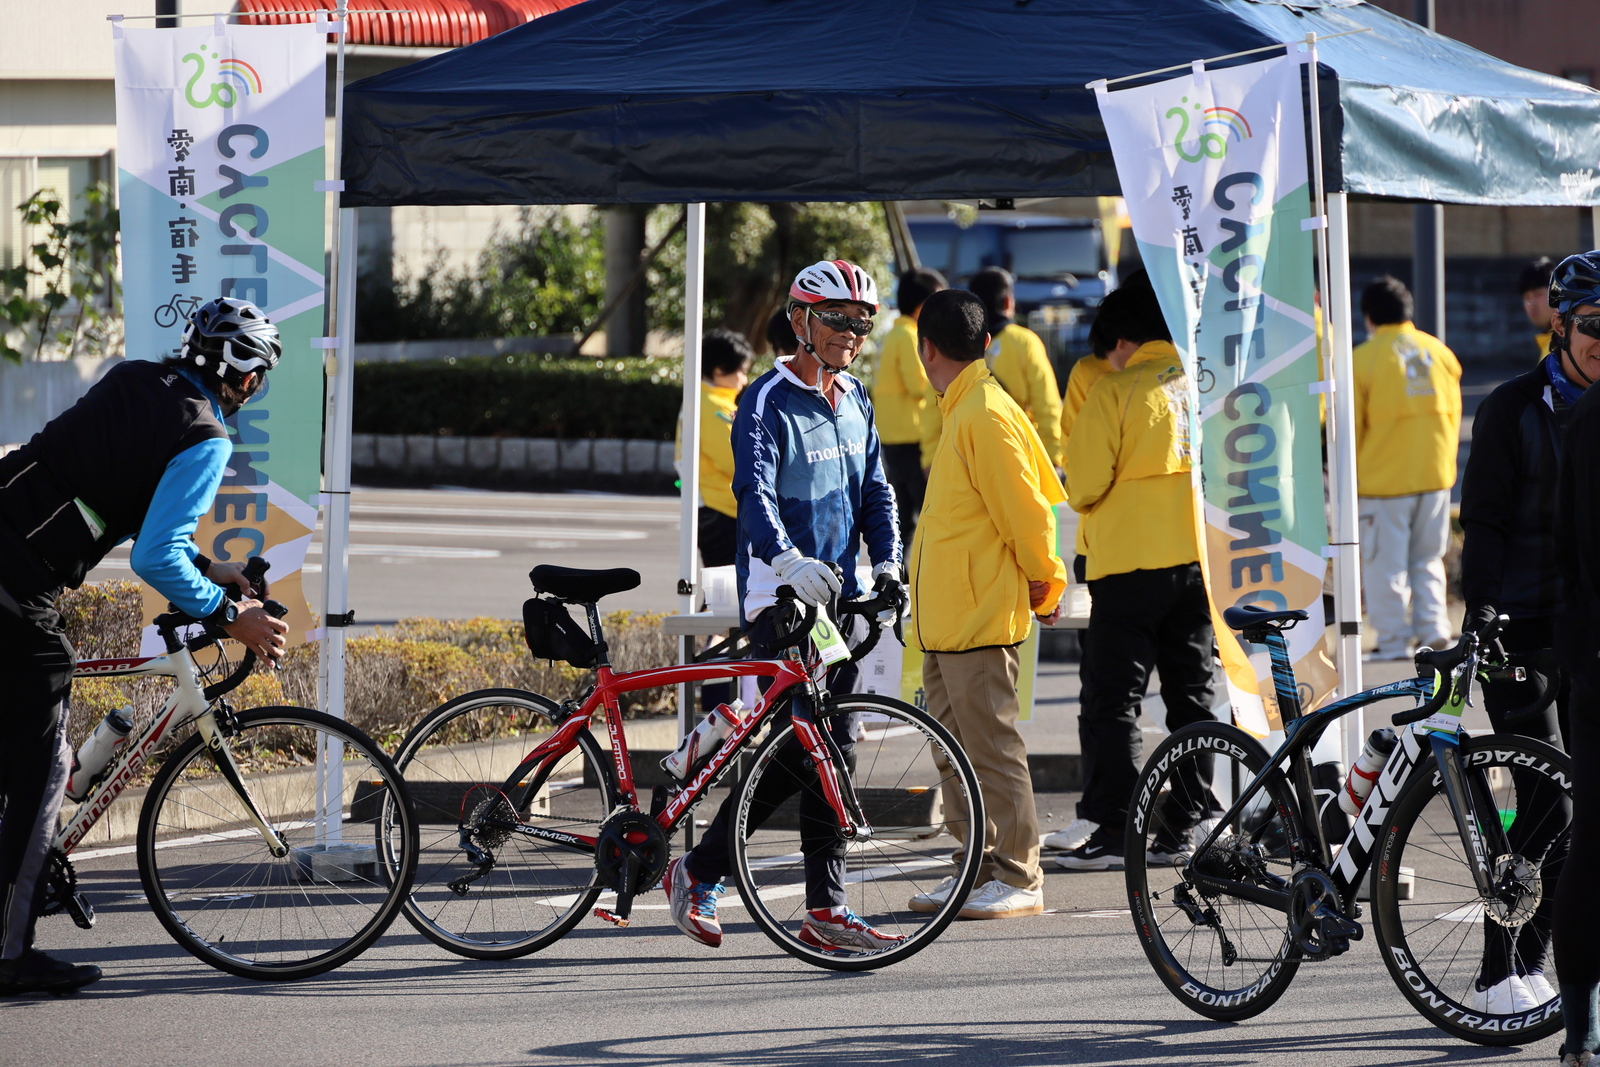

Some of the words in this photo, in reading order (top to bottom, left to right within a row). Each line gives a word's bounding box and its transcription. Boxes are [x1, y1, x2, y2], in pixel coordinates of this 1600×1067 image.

[63, 739, 157, 851] cannondale
[666, 698, 766, 820] PINARELLO
[1133, 735, 1249, 836] BONTRAGER
[515, 824, 579, 844] 30HM12K
[1465, 809, 1489, 872] TREK
[1390, 945, 1563, 1033] BONTRAGER
